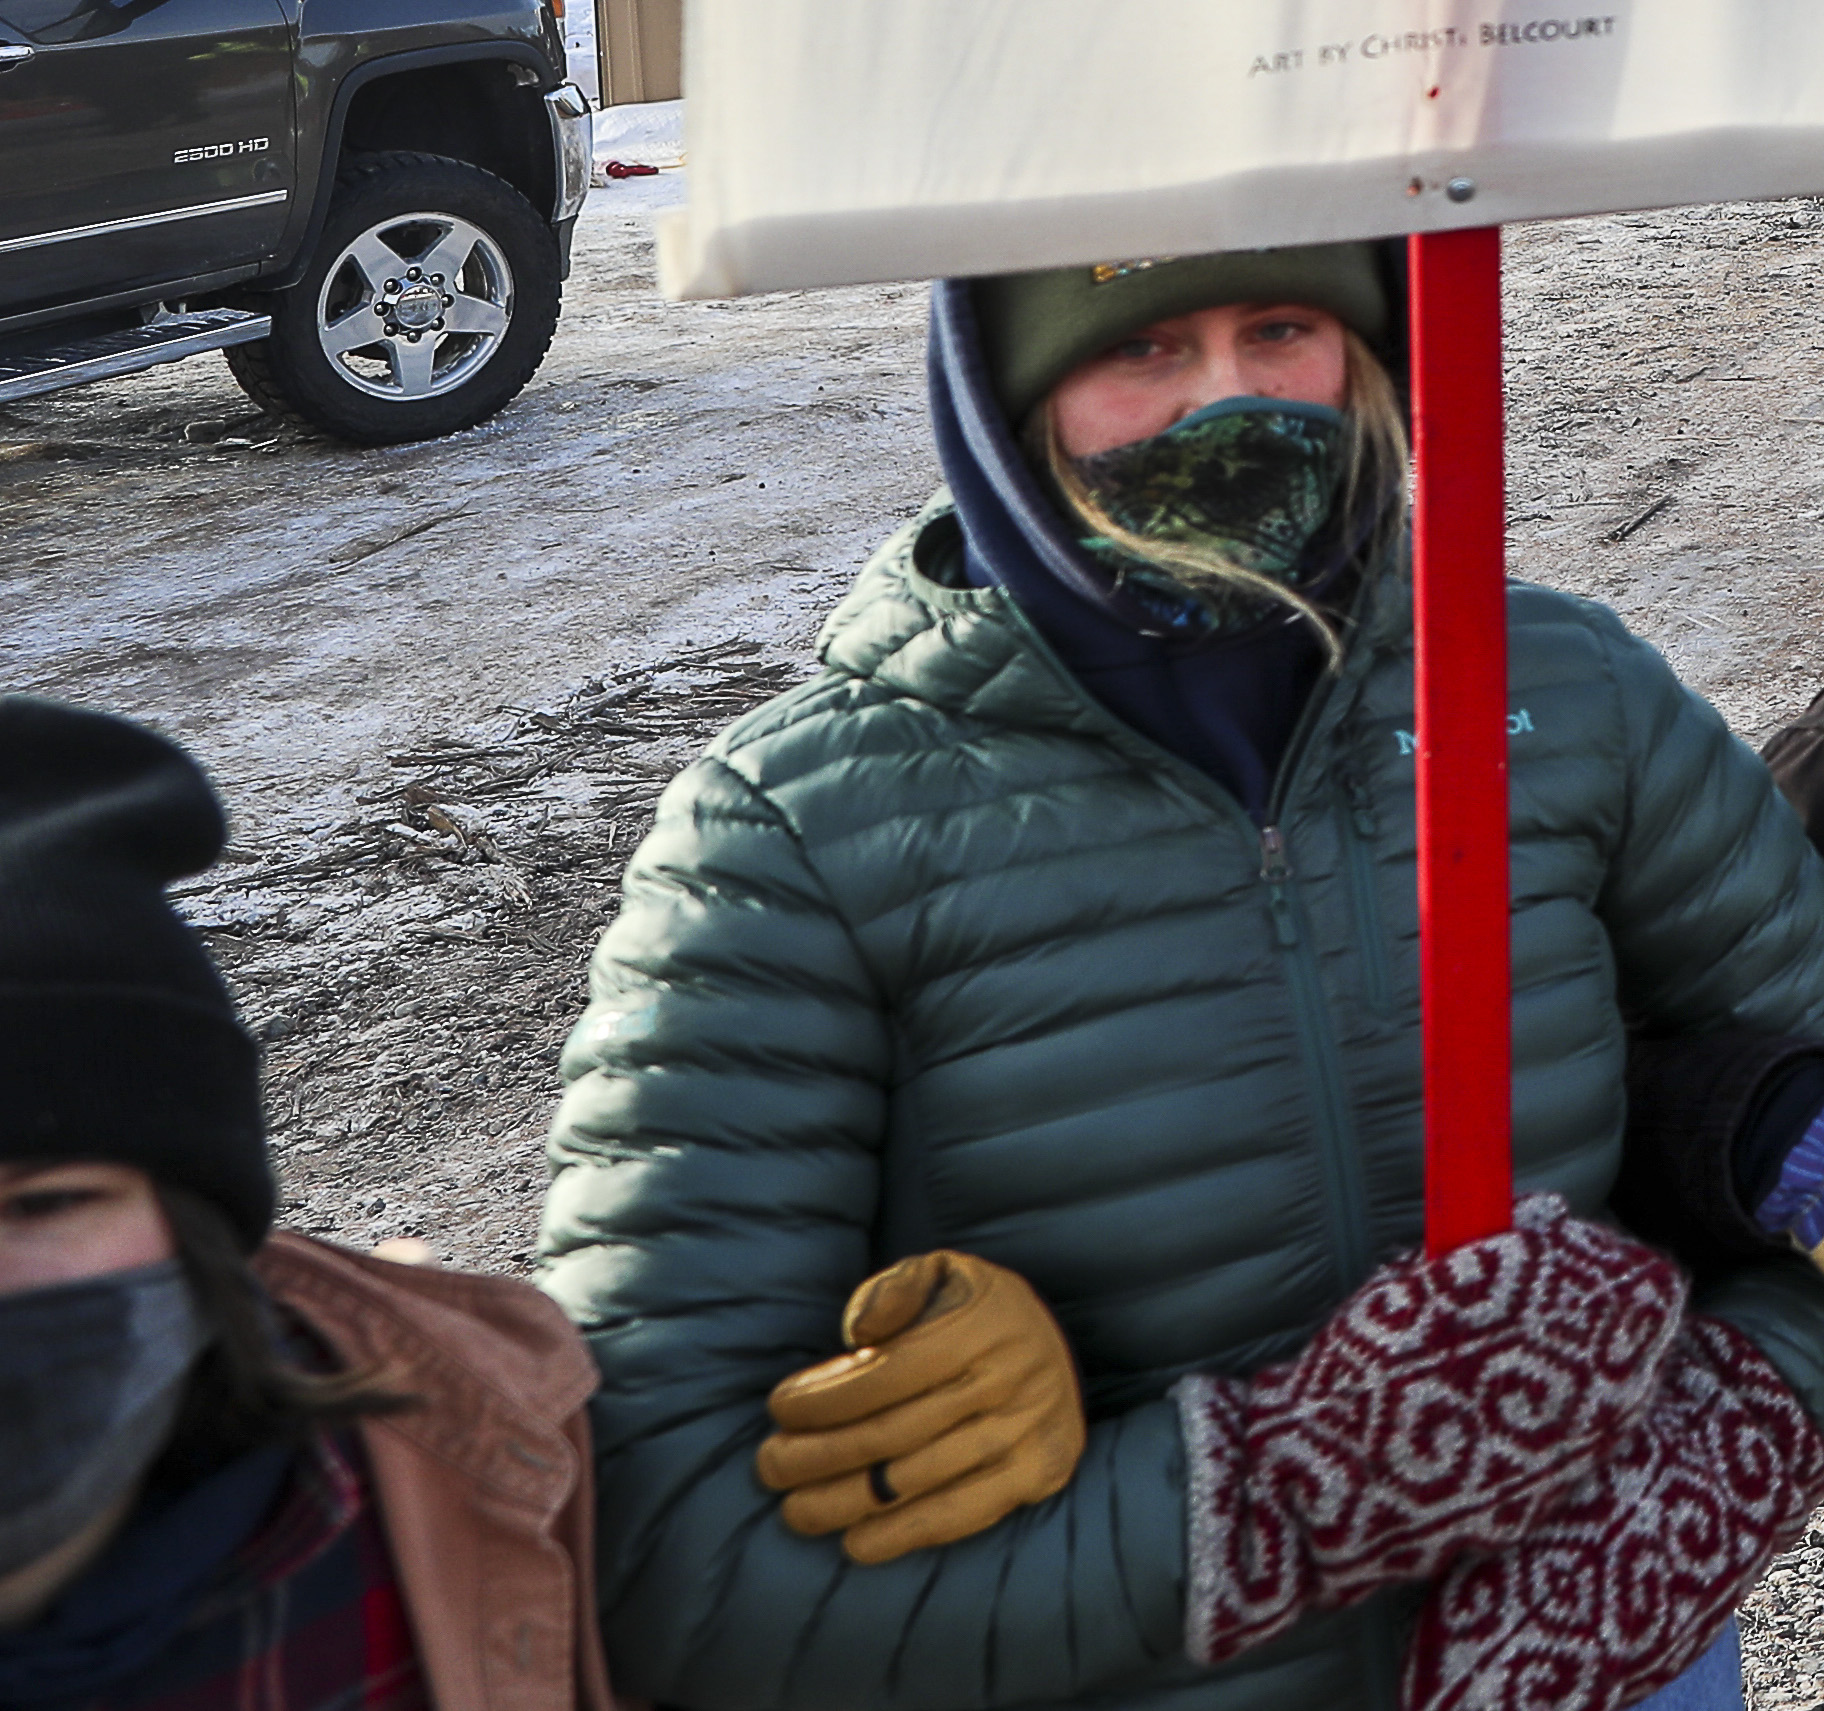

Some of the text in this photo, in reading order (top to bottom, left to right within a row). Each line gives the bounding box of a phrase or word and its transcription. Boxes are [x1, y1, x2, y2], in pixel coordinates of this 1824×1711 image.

[1247, 48, 1304, 78] ART
[1478, 15, 1617, 47] BELCOURT
[174, 137, 269, 164] 2500 HD
